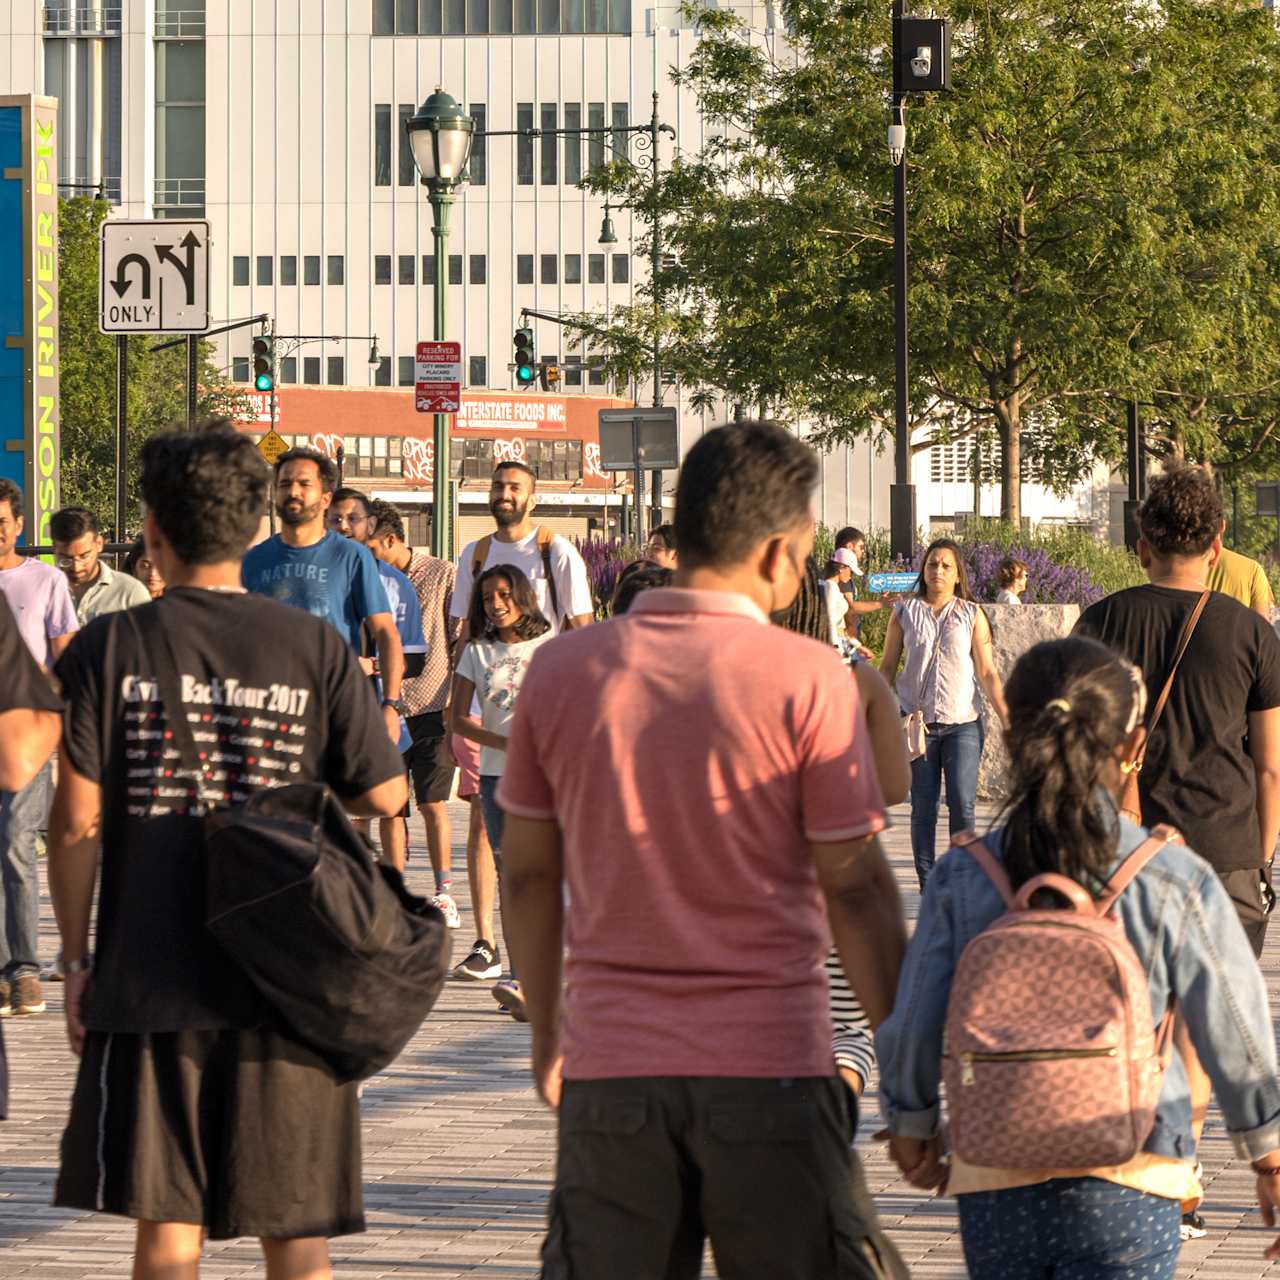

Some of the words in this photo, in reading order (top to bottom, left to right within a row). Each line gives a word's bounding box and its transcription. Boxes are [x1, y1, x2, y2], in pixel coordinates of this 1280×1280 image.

[36, 119, 53, 196] PK
[37, 212, 55, 377] RIVER
[110, 305, 153, 323] ONLY
[514, 403, 545, 421] FOODS
[261, 563, 329, 583] NATURE
[181, 674, 223, 705] Back
[224, 678, 269, 710] Tour
[267, 683, 310, 717] 2017
